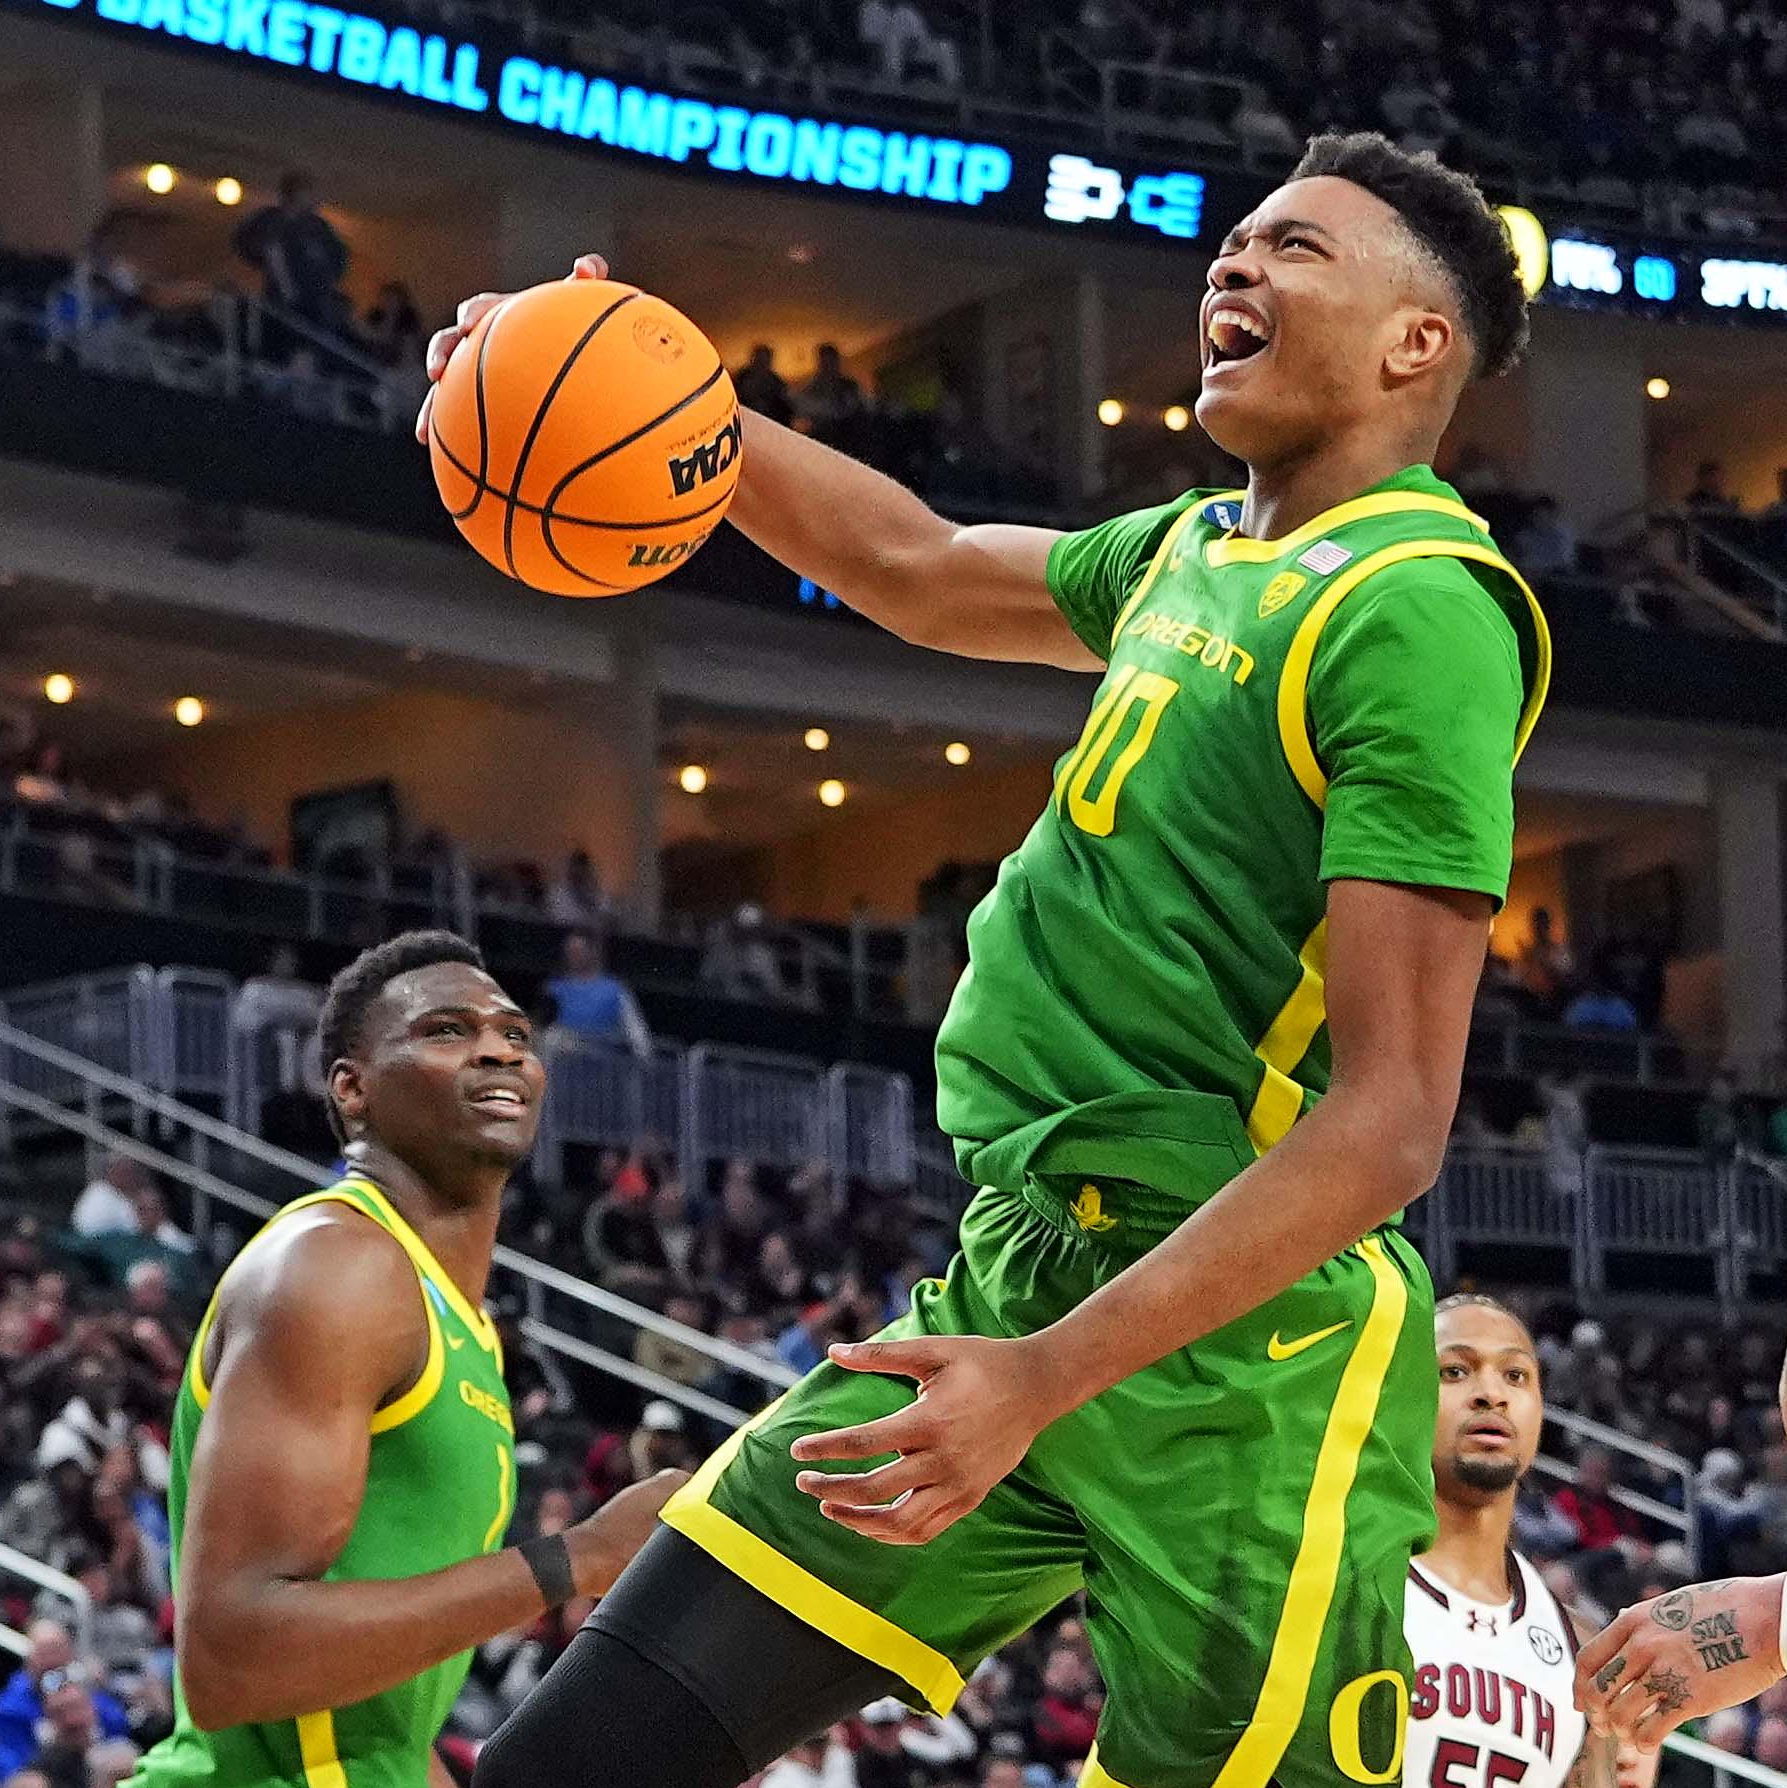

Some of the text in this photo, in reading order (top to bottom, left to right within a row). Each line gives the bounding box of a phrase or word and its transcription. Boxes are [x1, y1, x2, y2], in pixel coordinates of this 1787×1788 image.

[497, 56, 1014, 206] CHAMPIONSHIP
[1127, 611, 1256, 687] OREGON
[1054, 663, 1181, 838] 10
[1411, 1663, 1556, 1765] SOUTH
